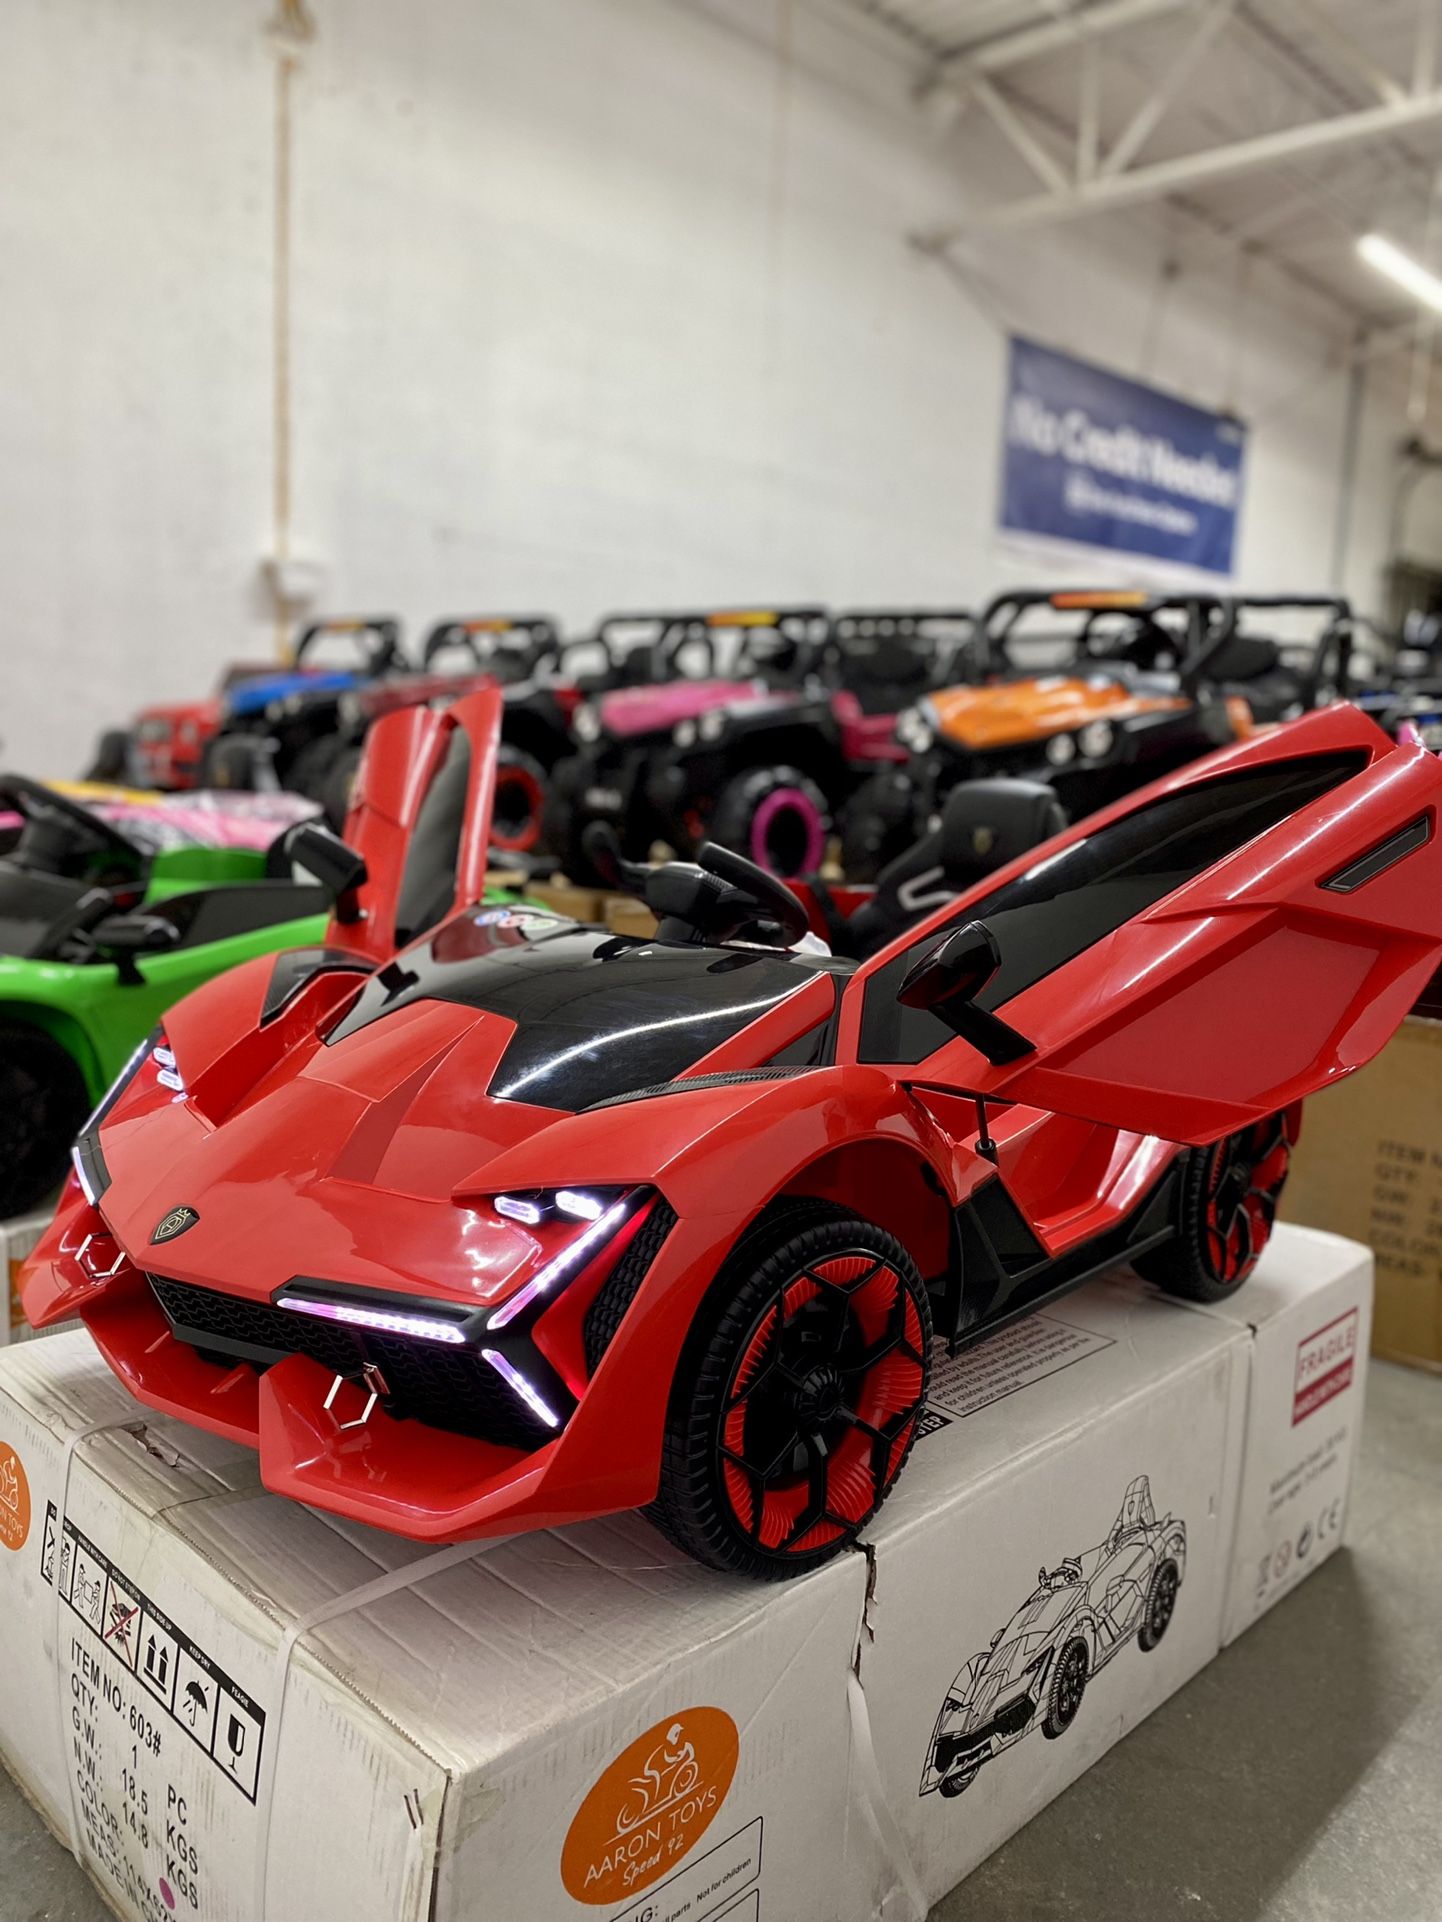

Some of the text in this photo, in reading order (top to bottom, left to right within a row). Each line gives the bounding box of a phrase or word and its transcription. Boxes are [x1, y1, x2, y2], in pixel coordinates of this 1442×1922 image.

[71, 1637, 161, 1757] ITEM NO: 603#
[71, 1673, 187, 1826] QTY: 1 PC
[77, 1769, 124, 1847] COLOR:
[87, 1827, 124, 1889] MADE
[122, 1767, 148, 1815] 18.5
[166, 1819, 198, 1875] KGS
[122, 1801, 149, 1849] 14.8
[166, 1853, 198, 1910] KGS
[584, 1785, 717, 1888] AARON TOYS
[622, 1845, 664, 1887] Speed
[670, 1902, 691, 1922] parts
[696, 1888, 710, 1903] Not
[711, 1880, 722, 1892] for
[722, 1857, 752, 1885] children
